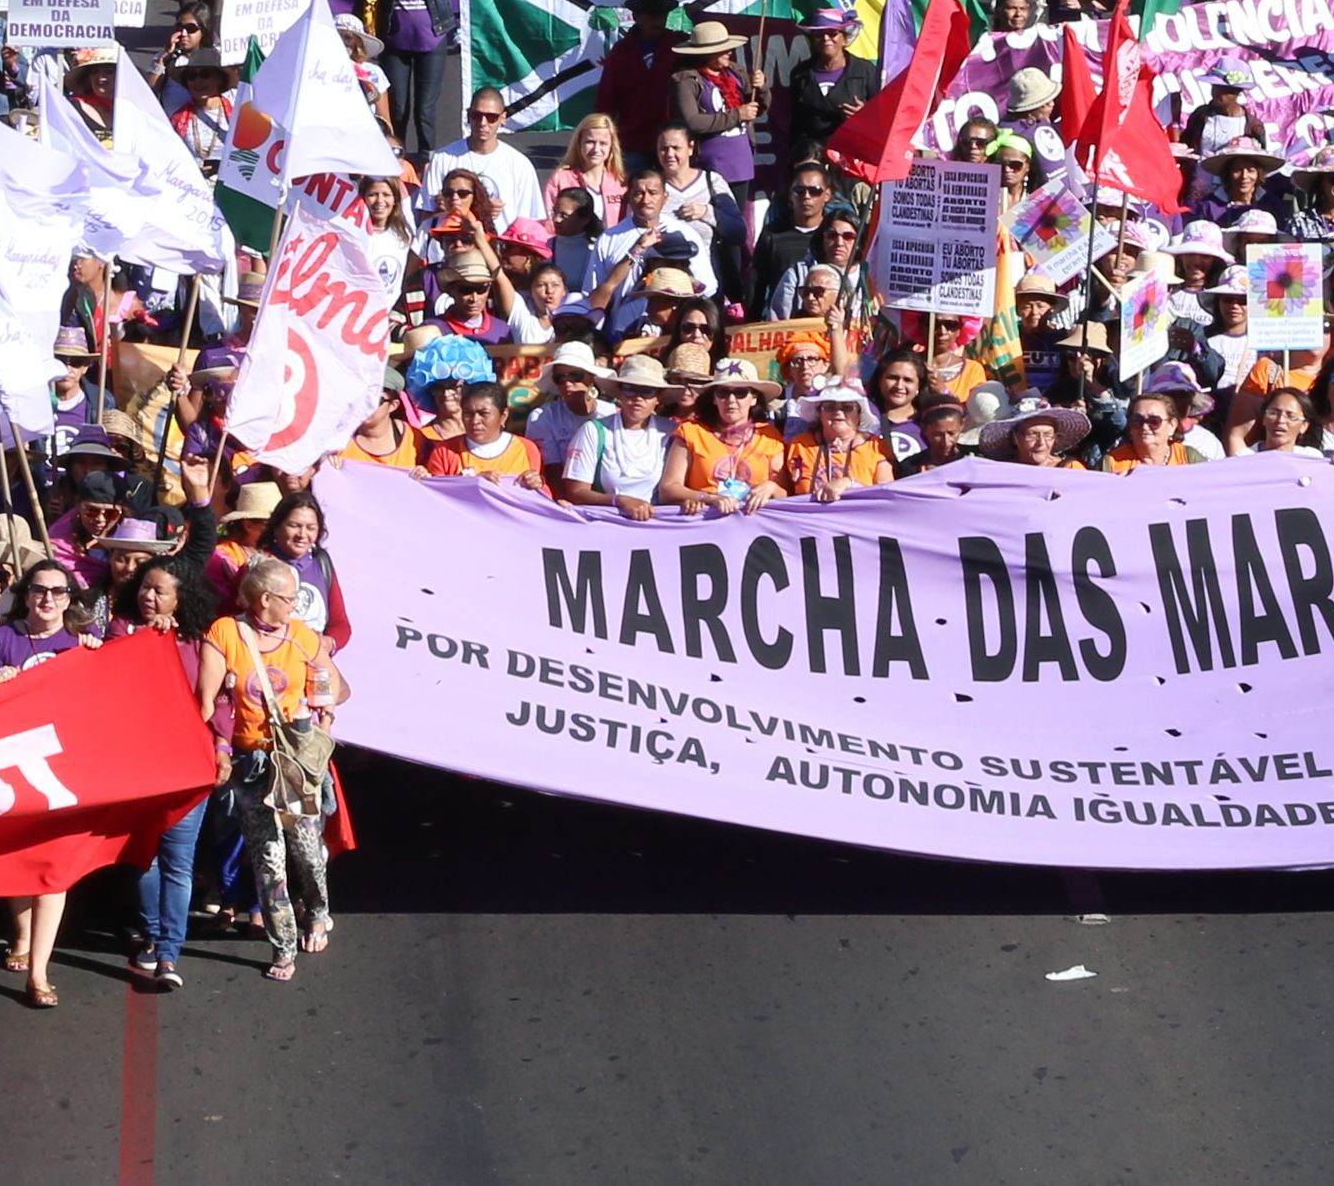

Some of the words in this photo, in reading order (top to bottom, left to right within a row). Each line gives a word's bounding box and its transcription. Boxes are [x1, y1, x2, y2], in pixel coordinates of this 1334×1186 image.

[51, 9, 71, 22] DA
[235, 2, 253, 17] EM
[257, 16, 273, 30] DA
[9, 23, 113, 40] DEMOCRACIA
[893, 191, 914, 205] SOMOS
[915, 193, 936, 208] TODAS
[943, 197, 987, 207] ABORTO
[891, 205, 934, 222] CLANDESTINAS
[955, 244, 985, 259] ABORTO
[891, 265, 933, 277] ABORTO
[953, 256, 985, 271] ABORTAS
[939, 285, 983, 302] CLANDESTINAS
[543, 531, 931, 684] MARCHA
[962, 528, 1128, 684] DAS
[393, 621, 491, 667] POR
[507, 647, 963, 775] DESENVOLVIMENTO
[977, 741, 1334, 787] SUSTENTÁVEL
[505, 699, 722, 780] JUSTIÇA,
[765, 754, 1059, 824] AUTONOMIA
